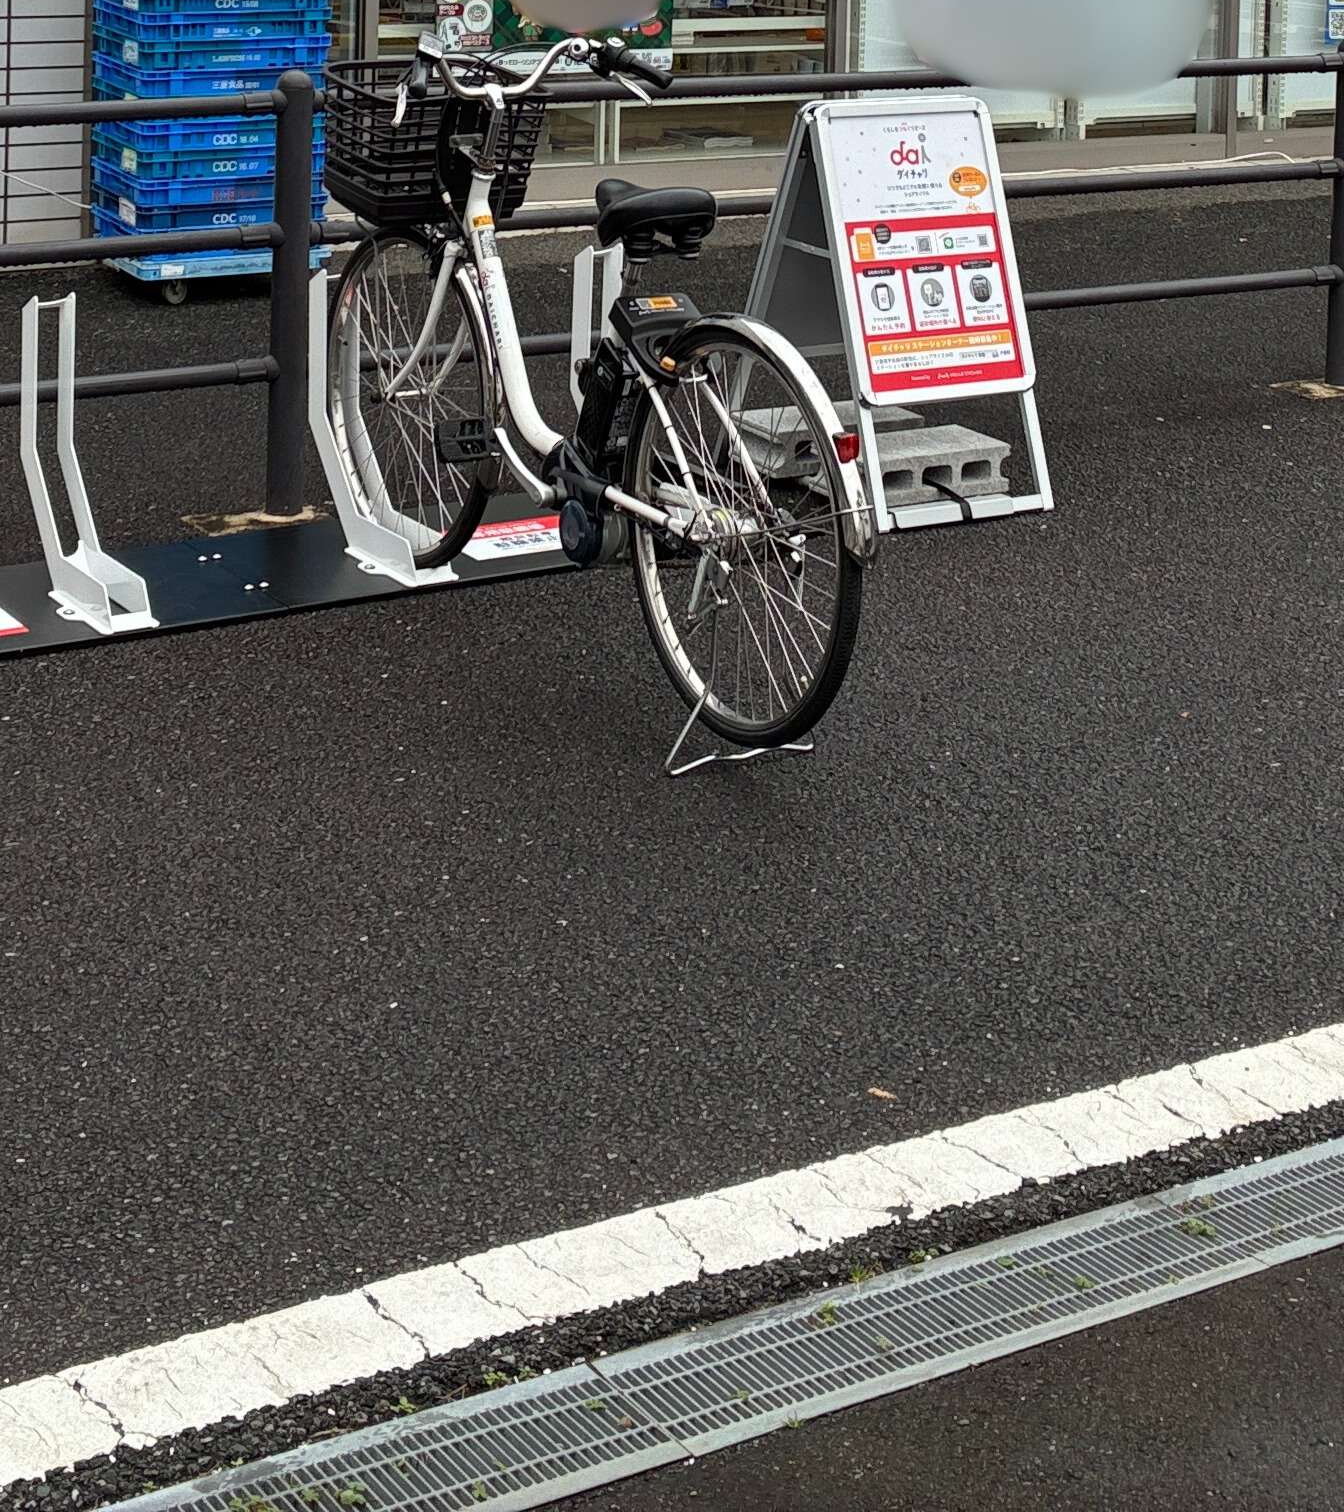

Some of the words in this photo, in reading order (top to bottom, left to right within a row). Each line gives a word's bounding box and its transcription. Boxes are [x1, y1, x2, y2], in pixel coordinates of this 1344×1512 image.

[213, 133, 238, 146] CDC
[212, 161, 238, 173] CDC
[212, 213, 237, 225] CDC
